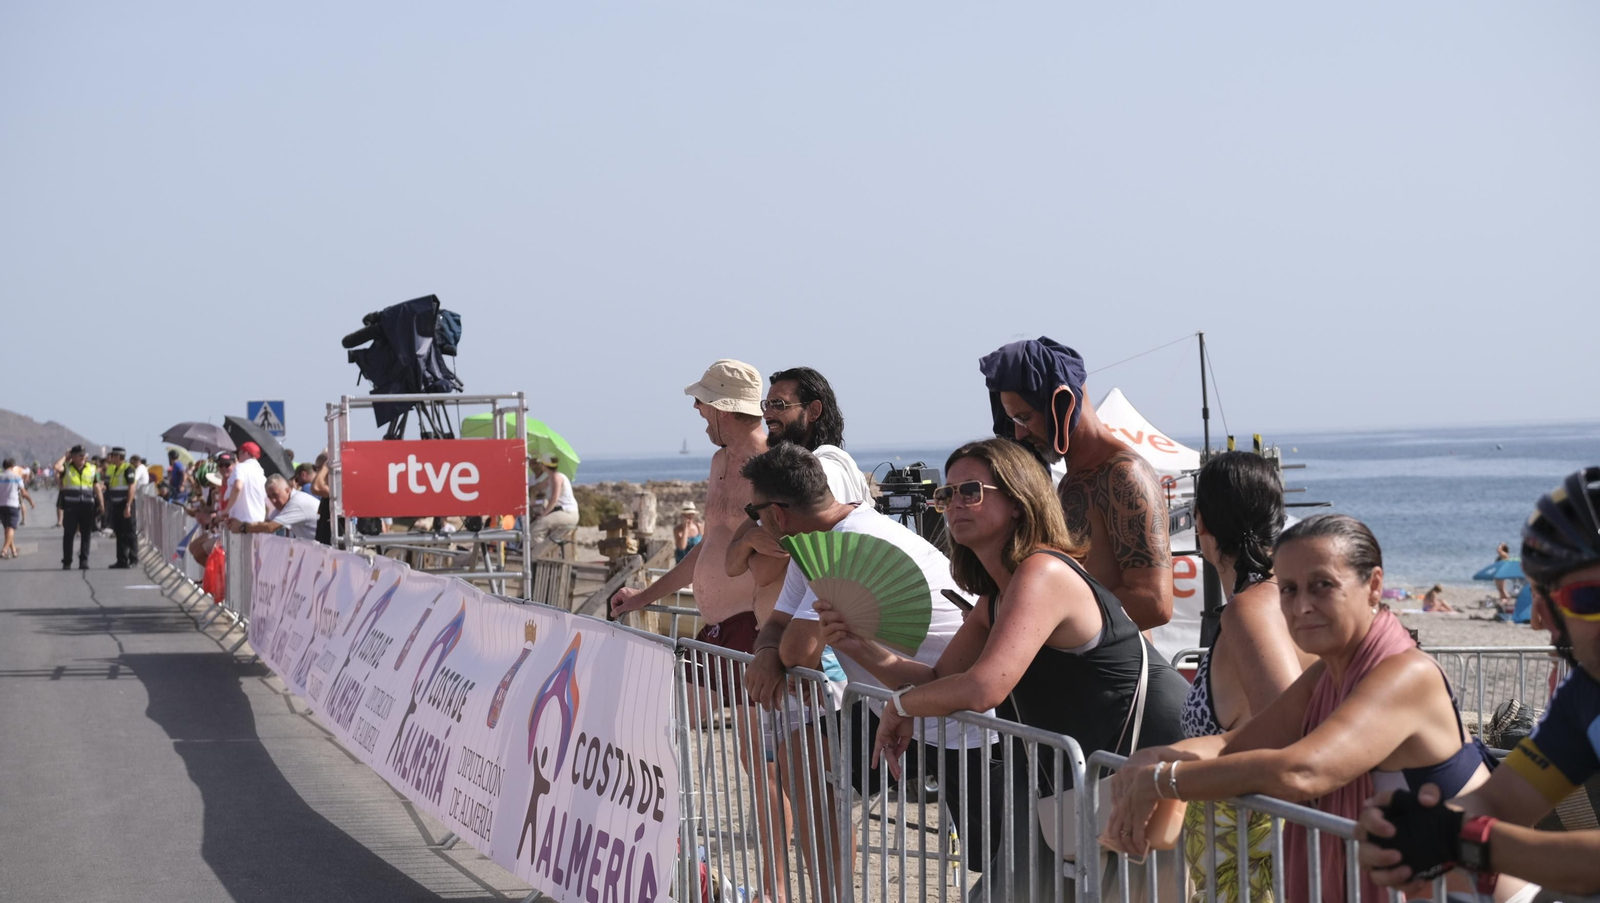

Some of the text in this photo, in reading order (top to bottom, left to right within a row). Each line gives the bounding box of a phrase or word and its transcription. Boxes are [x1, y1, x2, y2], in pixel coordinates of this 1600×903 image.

[1103, 422, 1179, 454] ve
[388, 454, 480, 502] rtve
[427, 666, 476, 723] COSTA DE
[394, 722, 452, 807] ALMERÍA
[457, 746, 506, 798] DIPUTACIÓN
[572, 732, 665, 823] COSTA DE
[448, 787, 493, 842] DE ALMERÍA
[536, 805, 658, 903] ALMERÍA
